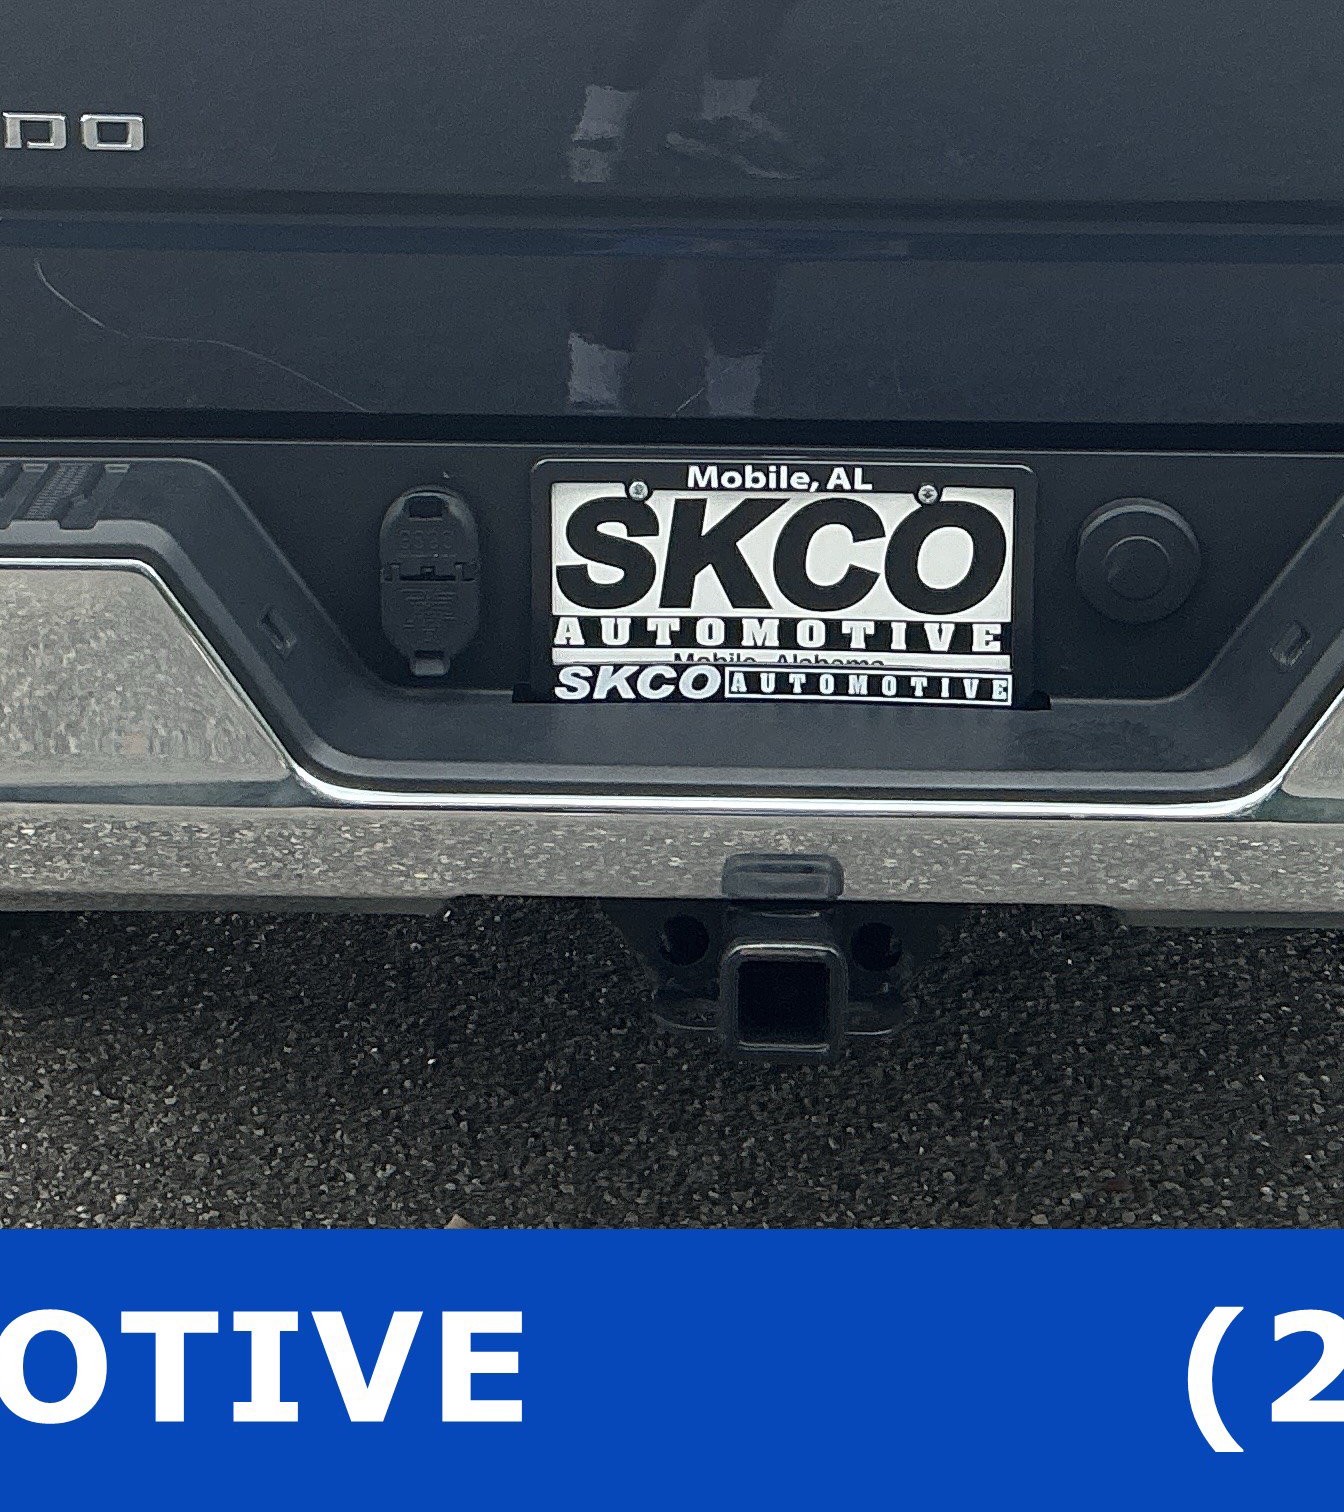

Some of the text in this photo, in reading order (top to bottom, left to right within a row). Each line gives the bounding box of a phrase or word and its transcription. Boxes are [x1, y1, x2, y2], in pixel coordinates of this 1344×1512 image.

[686, 464, 873, 493] Mobile, AL
[555, 496, 1008, 616] SKCO
[553, 616, 1003, 653] AUTOMOTIVE
[554, 664, 1007, 701] SKCO AUTOMOTIVE
